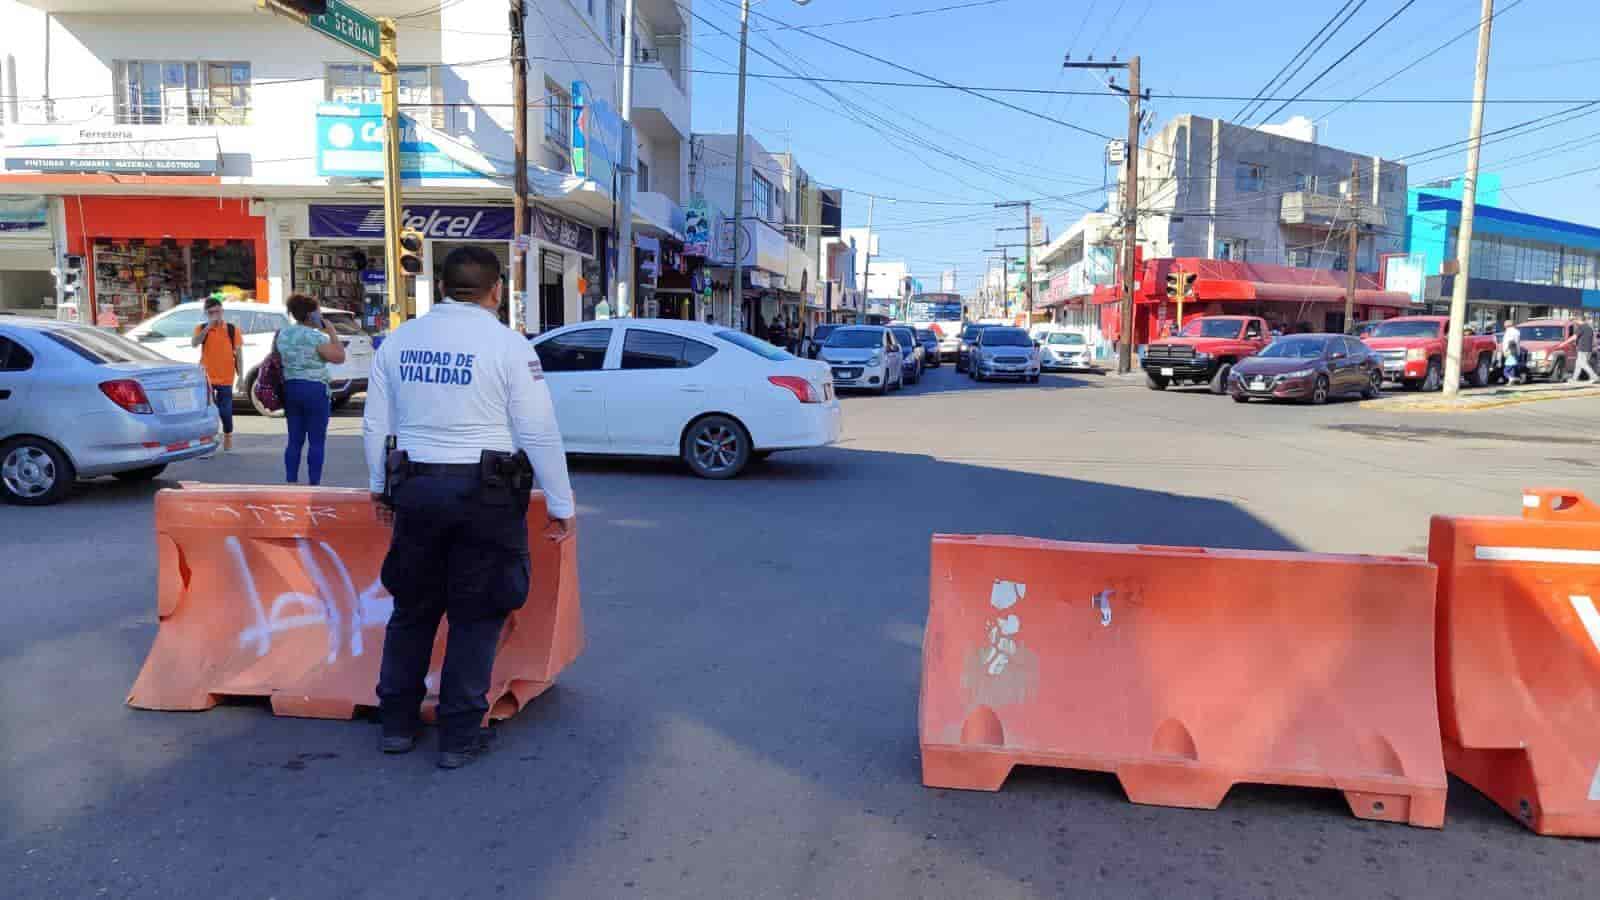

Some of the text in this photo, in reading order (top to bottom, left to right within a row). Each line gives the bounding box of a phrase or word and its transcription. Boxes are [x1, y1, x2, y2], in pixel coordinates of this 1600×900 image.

[335, 12, 375, 48] SERDAN
[401, 208, 484, 237] telcel
[400, 350, 474, 367] UNIDAD DE
[400, 365, 473, 385] VIALIDAD
